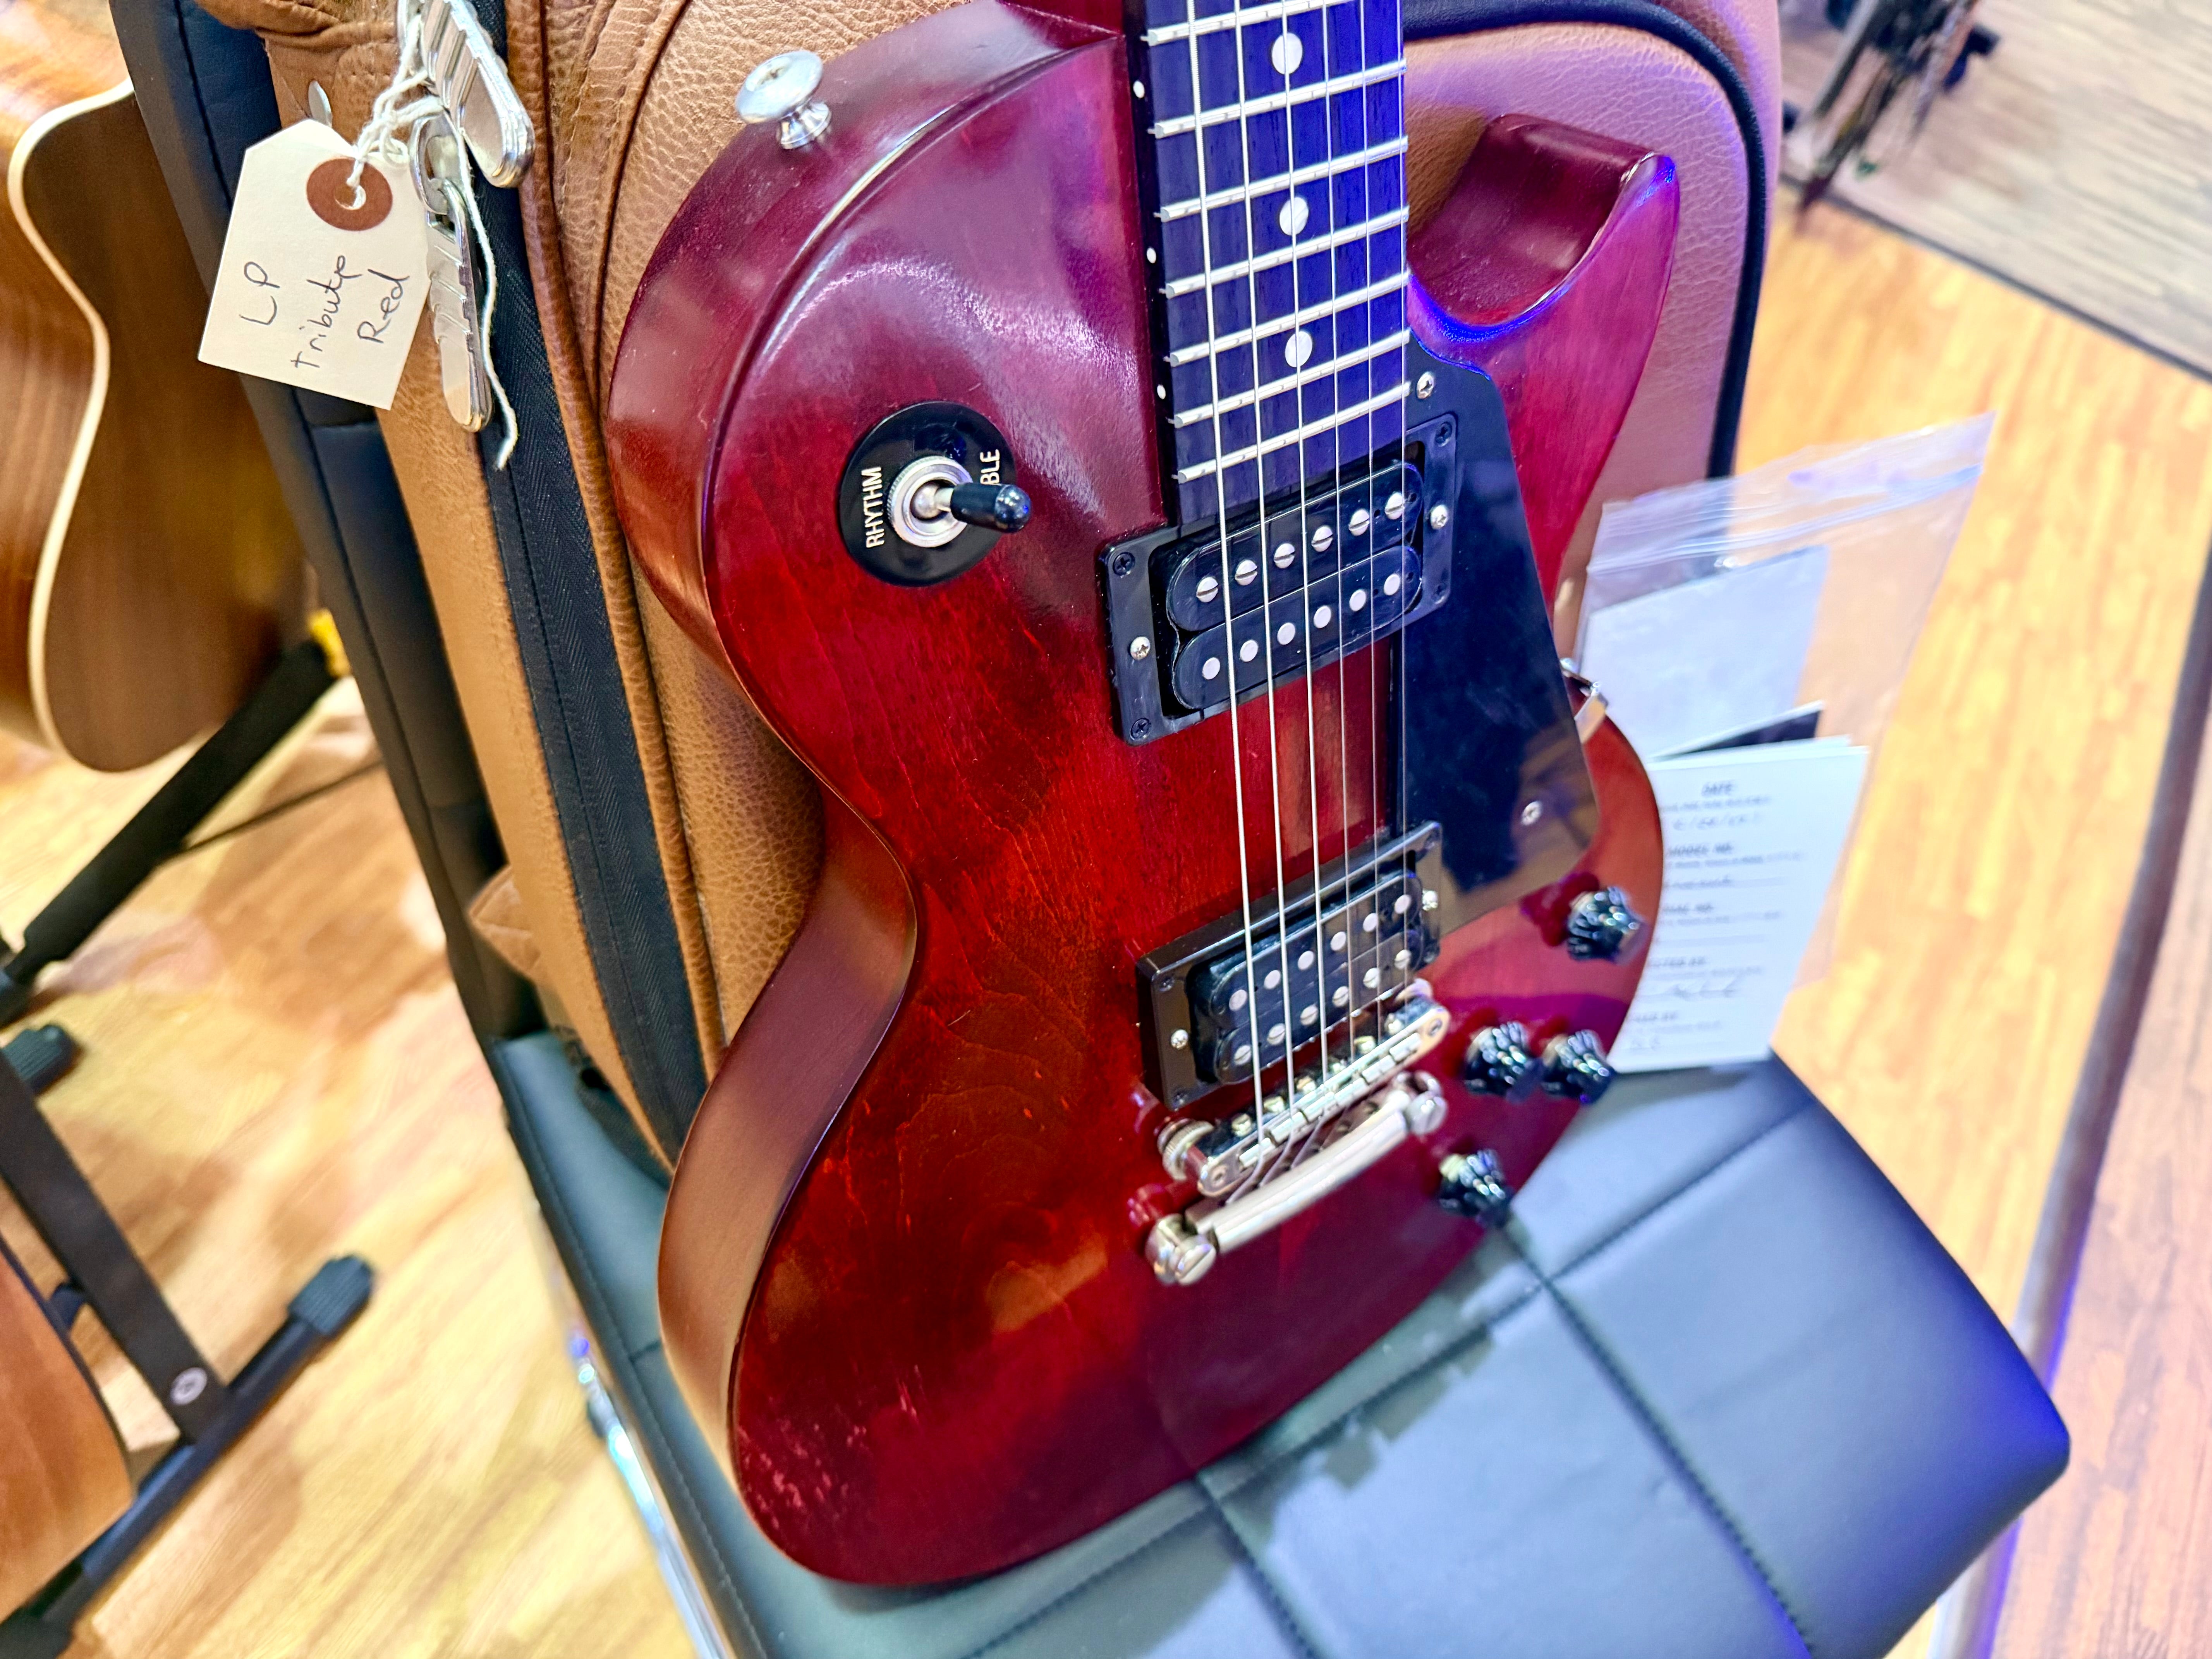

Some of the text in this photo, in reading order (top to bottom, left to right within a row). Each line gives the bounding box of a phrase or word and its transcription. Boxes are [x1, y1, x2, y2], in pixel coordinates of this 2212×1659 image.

[239, 261, 281, 325] LP
[357, 269, 410, 344] Red
[980, 449, 1000, 485] BLE
[861, 466, 884, 548] RHYTHM
